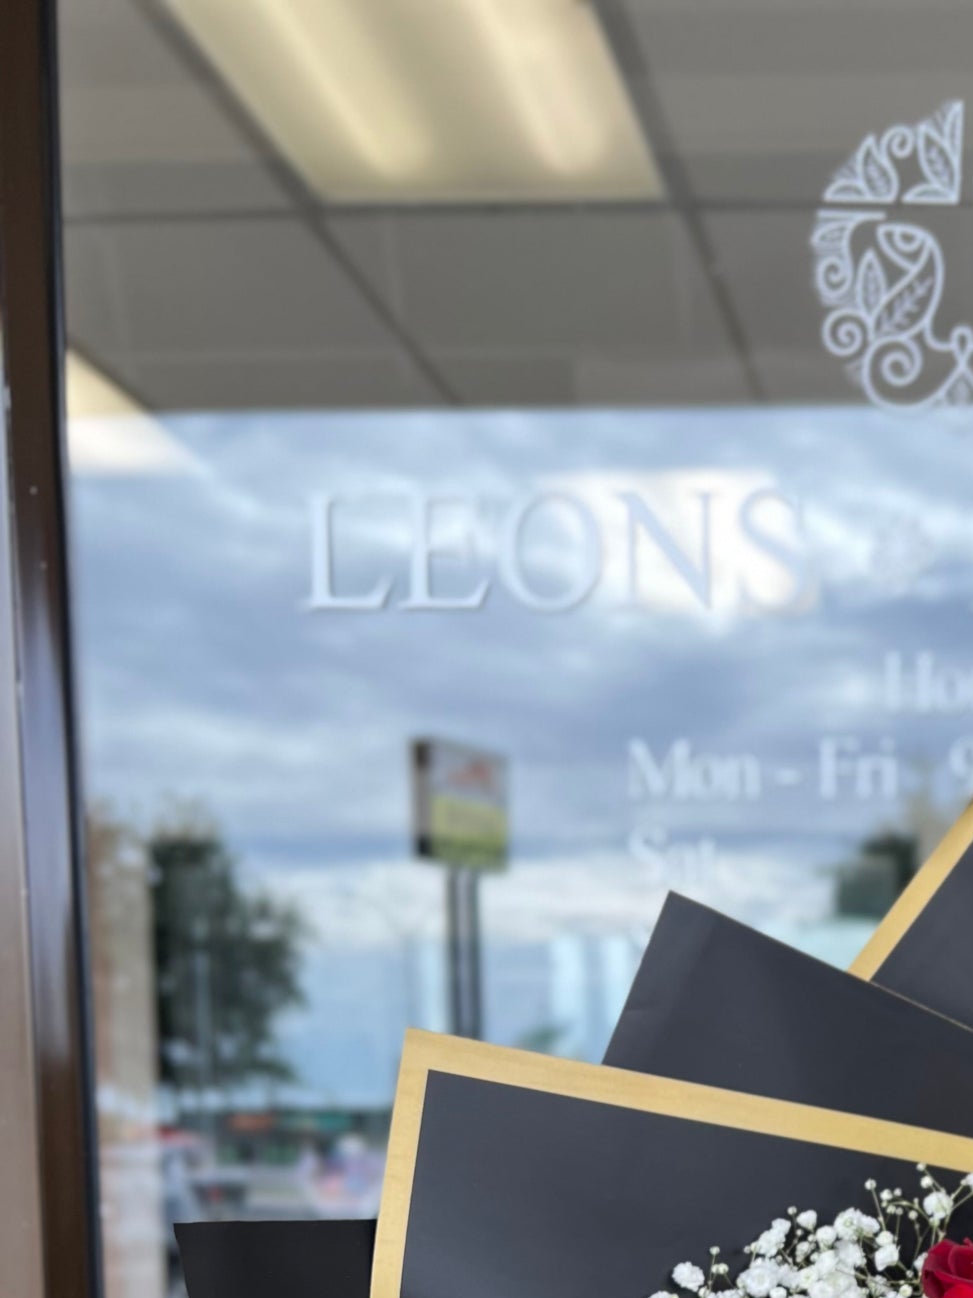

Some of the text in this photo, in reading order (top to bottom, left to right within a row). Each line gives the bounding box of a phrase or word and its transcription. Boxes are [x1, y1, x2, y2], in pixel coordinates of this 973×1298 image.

[302, 486, 808, 613] LEONS
[626, 737, 763, 800] Mon
[816, 736, 900, 800] Fri
[626, 821, 719, 886] Sat
